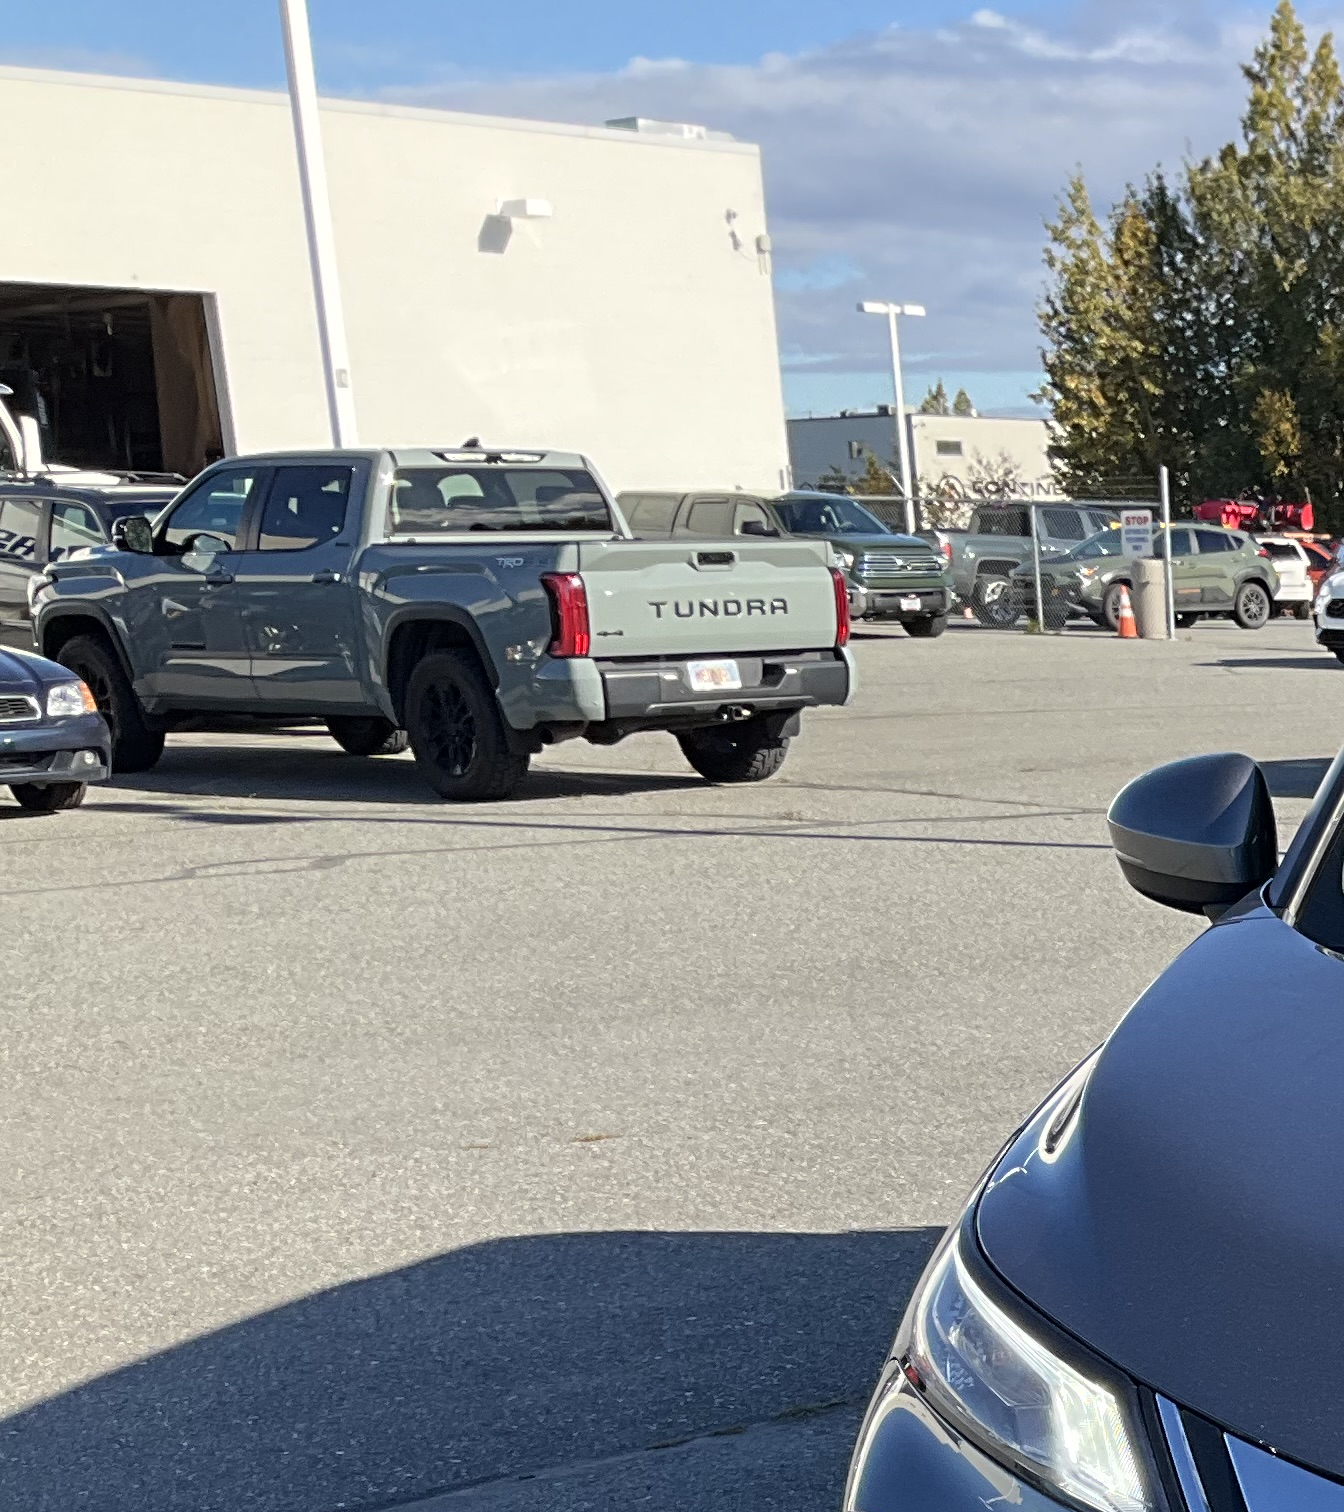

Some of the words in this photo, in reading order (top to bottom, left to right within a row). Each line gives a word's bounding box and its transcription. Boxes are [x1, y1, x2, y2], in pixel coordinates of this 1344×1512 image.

[1125, 516, 1149, 526] STOP
[496, 557, 524, 568] TRD
[648, 598, 789, 618] TUNDRA
